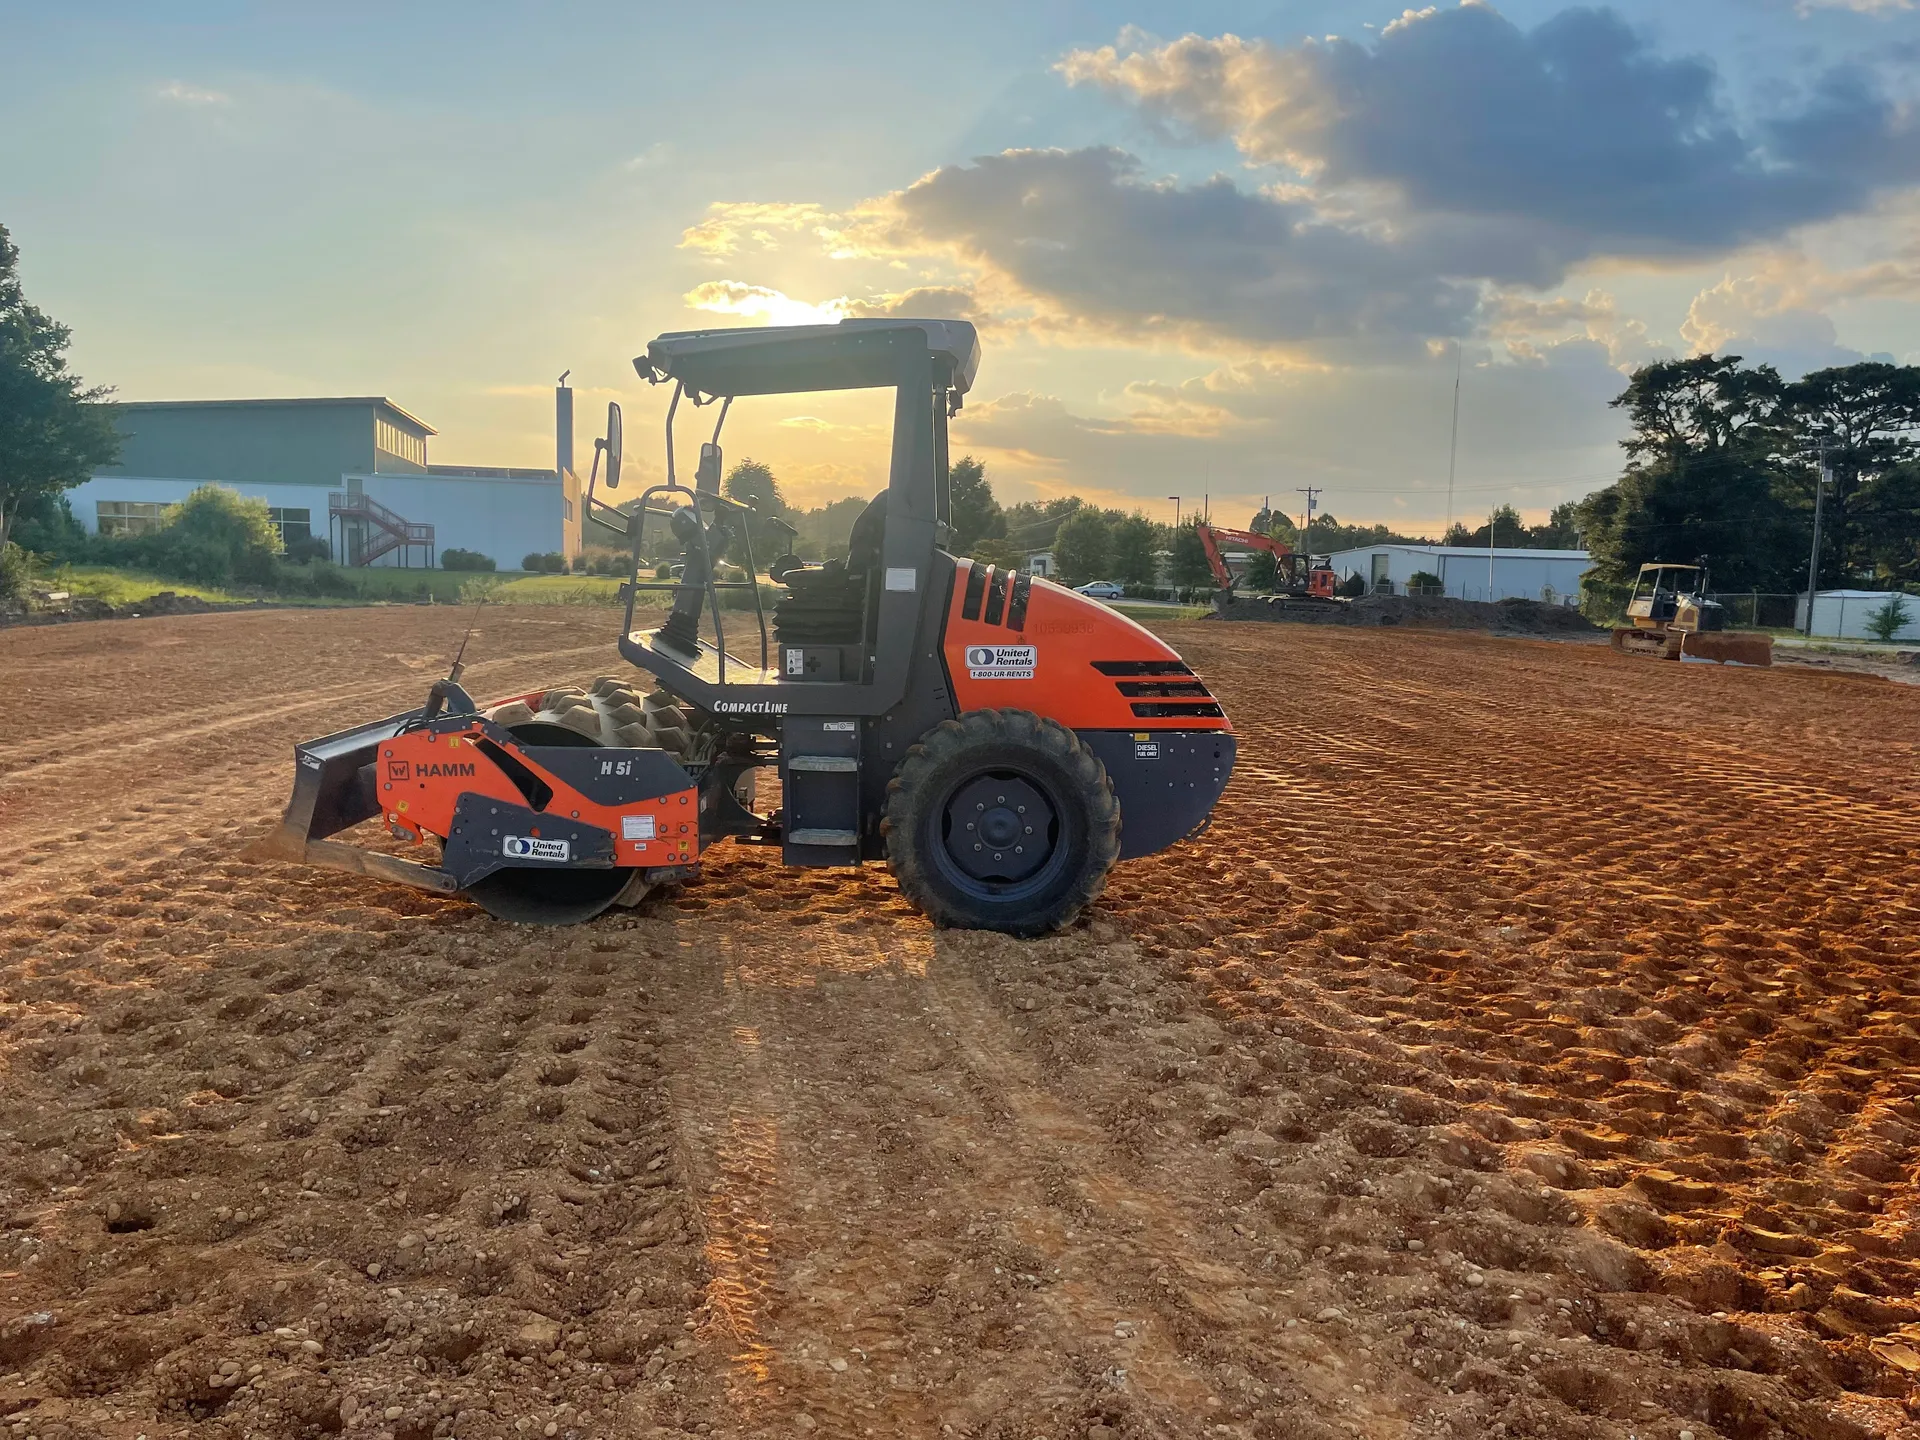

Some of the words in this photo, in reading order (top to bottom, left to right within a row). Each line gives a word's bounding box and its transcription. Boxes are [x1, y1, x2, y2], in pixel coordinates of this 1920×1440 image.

[996, 648, 1030, 657] United
[996, 657, 1033, 666] Rentals
[416, 763, 475, 777] HAMM
[600, 761, 613, 775] H
[615, 760, 632, 776] 5i
[532, 841, 564, 851] United
[531, 848, 566, 859] Rentals
